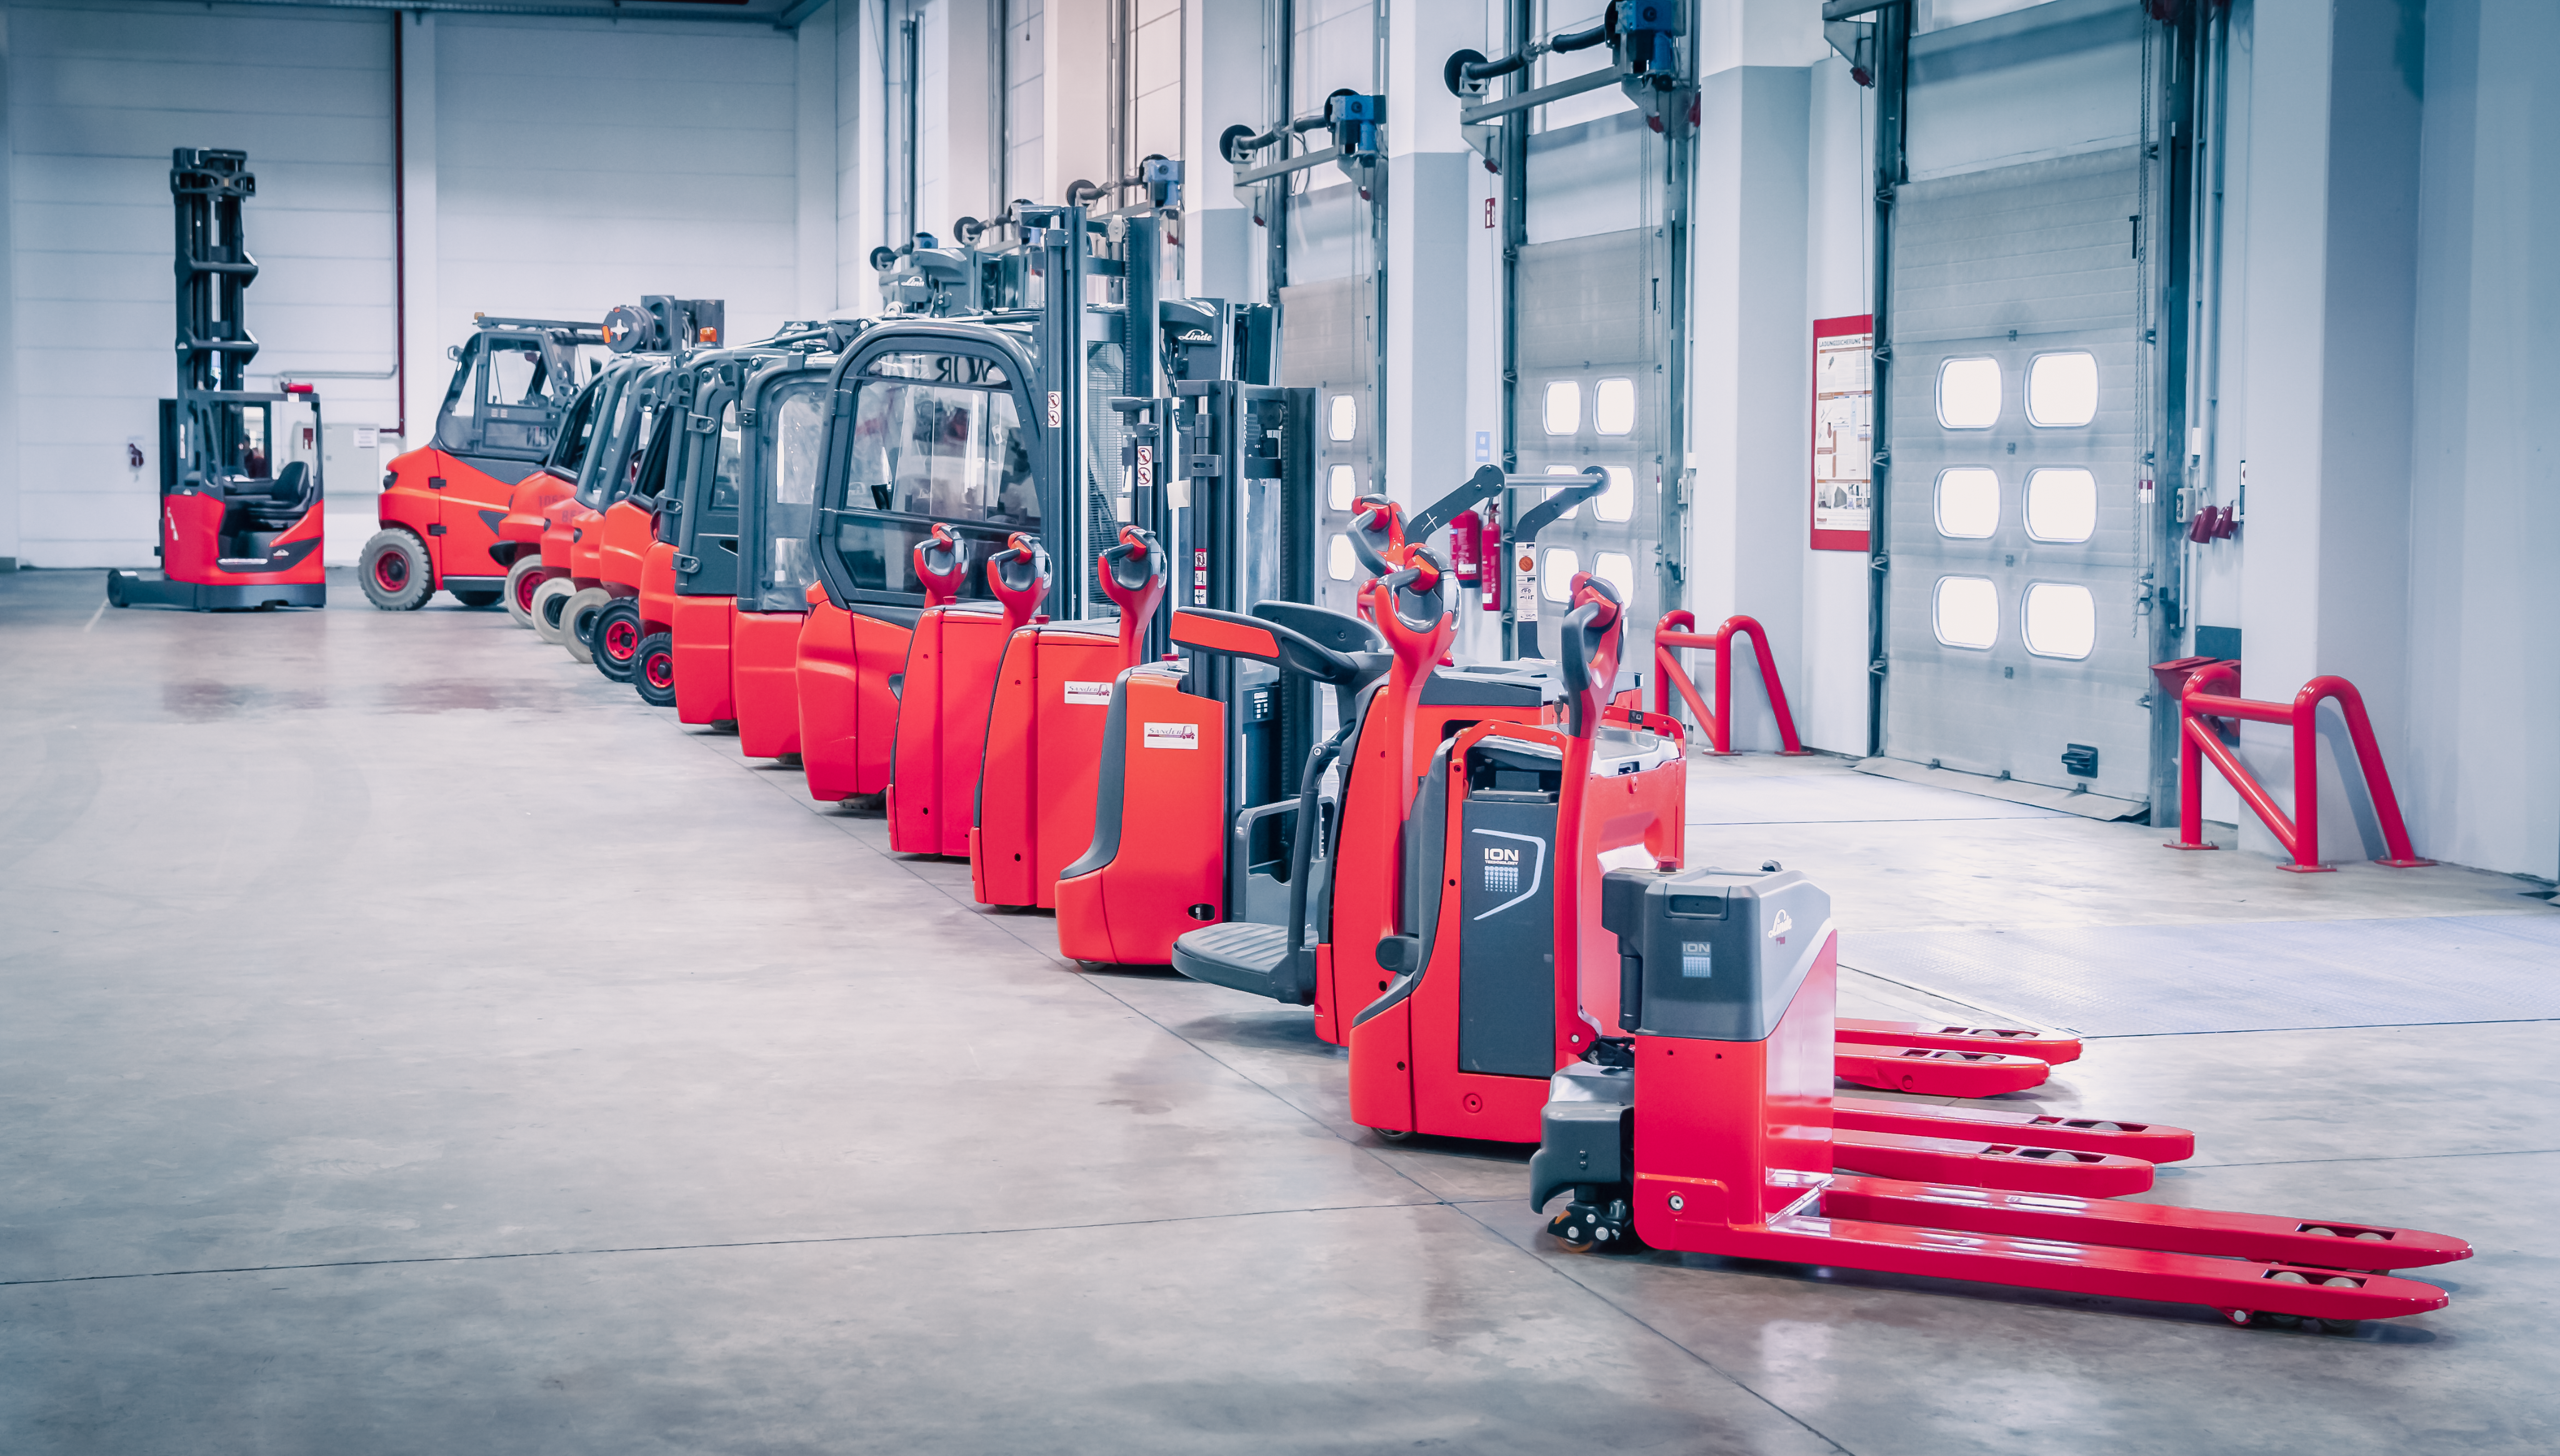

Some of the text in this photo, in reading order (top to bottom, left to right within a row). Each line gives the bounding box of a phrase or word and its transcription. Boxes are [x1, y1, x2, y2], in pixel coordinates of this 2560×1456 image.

[1178, 329, 1212, 341] Linde
[1819, 338, 1861, 347] LADUNGSSICHERUNG
[1484, 847, 1519, 862] ION
[1682, 943, 1710, 953] ION
